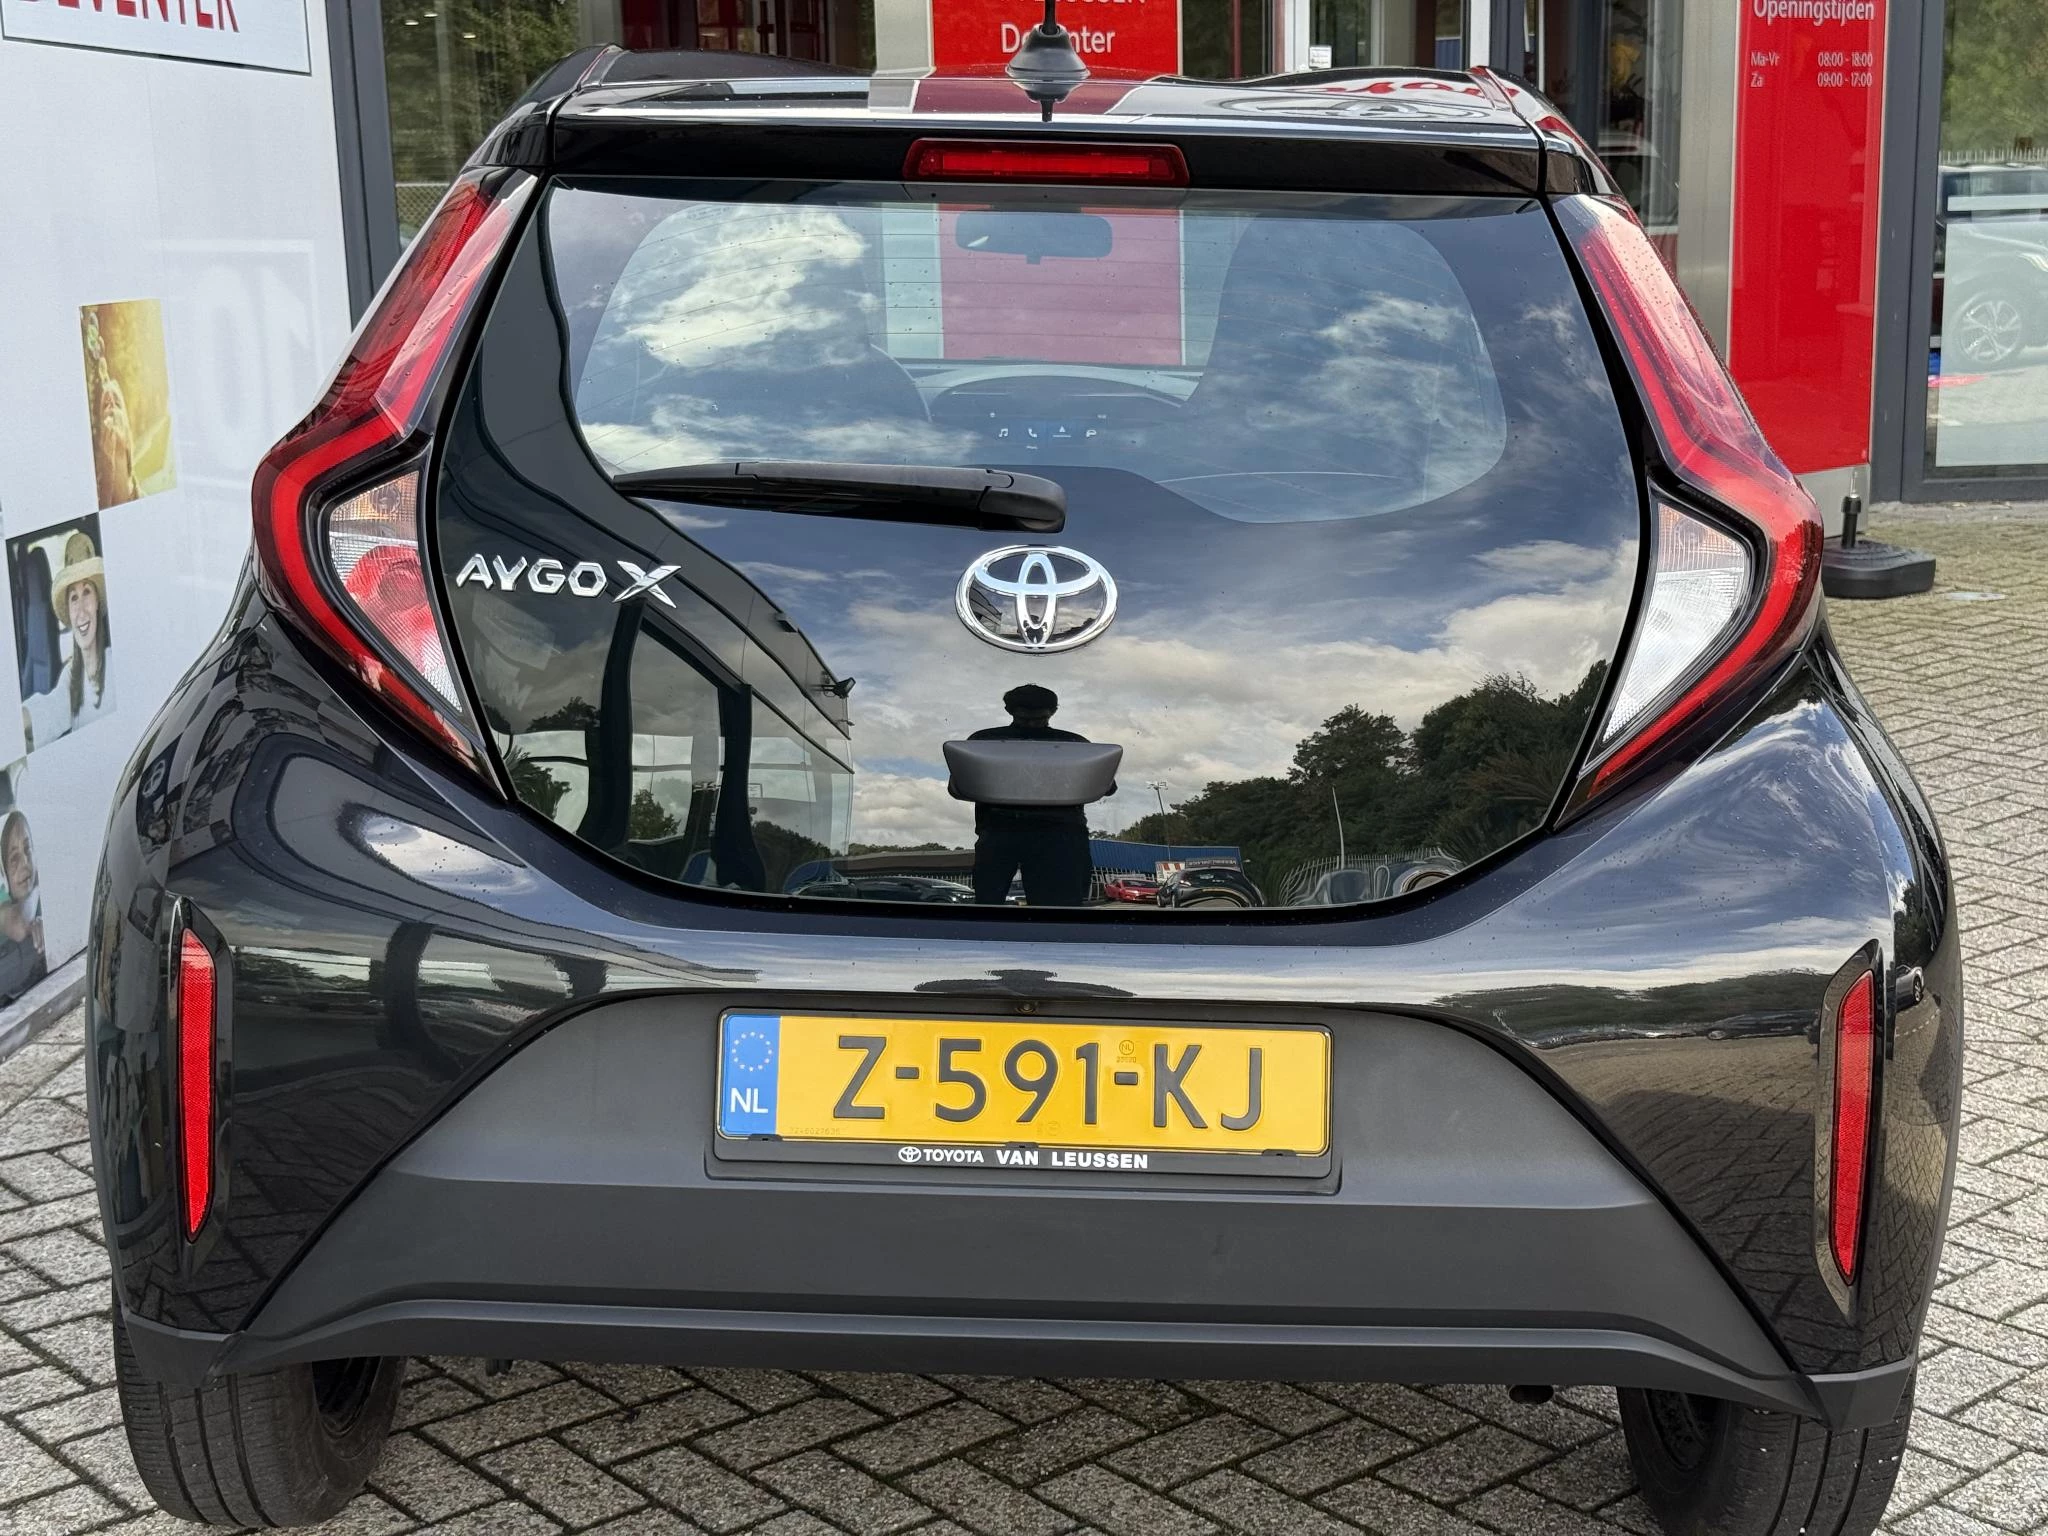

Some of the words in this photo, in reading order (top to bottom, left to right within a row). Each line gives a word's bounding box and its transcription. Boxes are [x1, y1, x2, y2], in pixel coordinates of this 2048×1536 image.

[1754, 0, 1875, 26] Openingstijden
[1750, 52, 1780, 67] Ma-Vr
[1817, 52, 1843, 67] 08:00
[1851, 52, 1873, 67] 18:00
[1750, 73, 1763, 87] Za
[1817, 73, 1842, 87] 09:00
[455, 553, 608, 597] AYGO
[612, 560, 682, 609] X
[833, 1034, 1264, 1131] Z-591-KJ
[730, 1087, 768, 1113] NL
[923, 1149, 985, 1163] TOYOTA
[996, 1150, 1039, 1165] VAN
[1051, 1152, 1149, 1169] LEUSSEN
